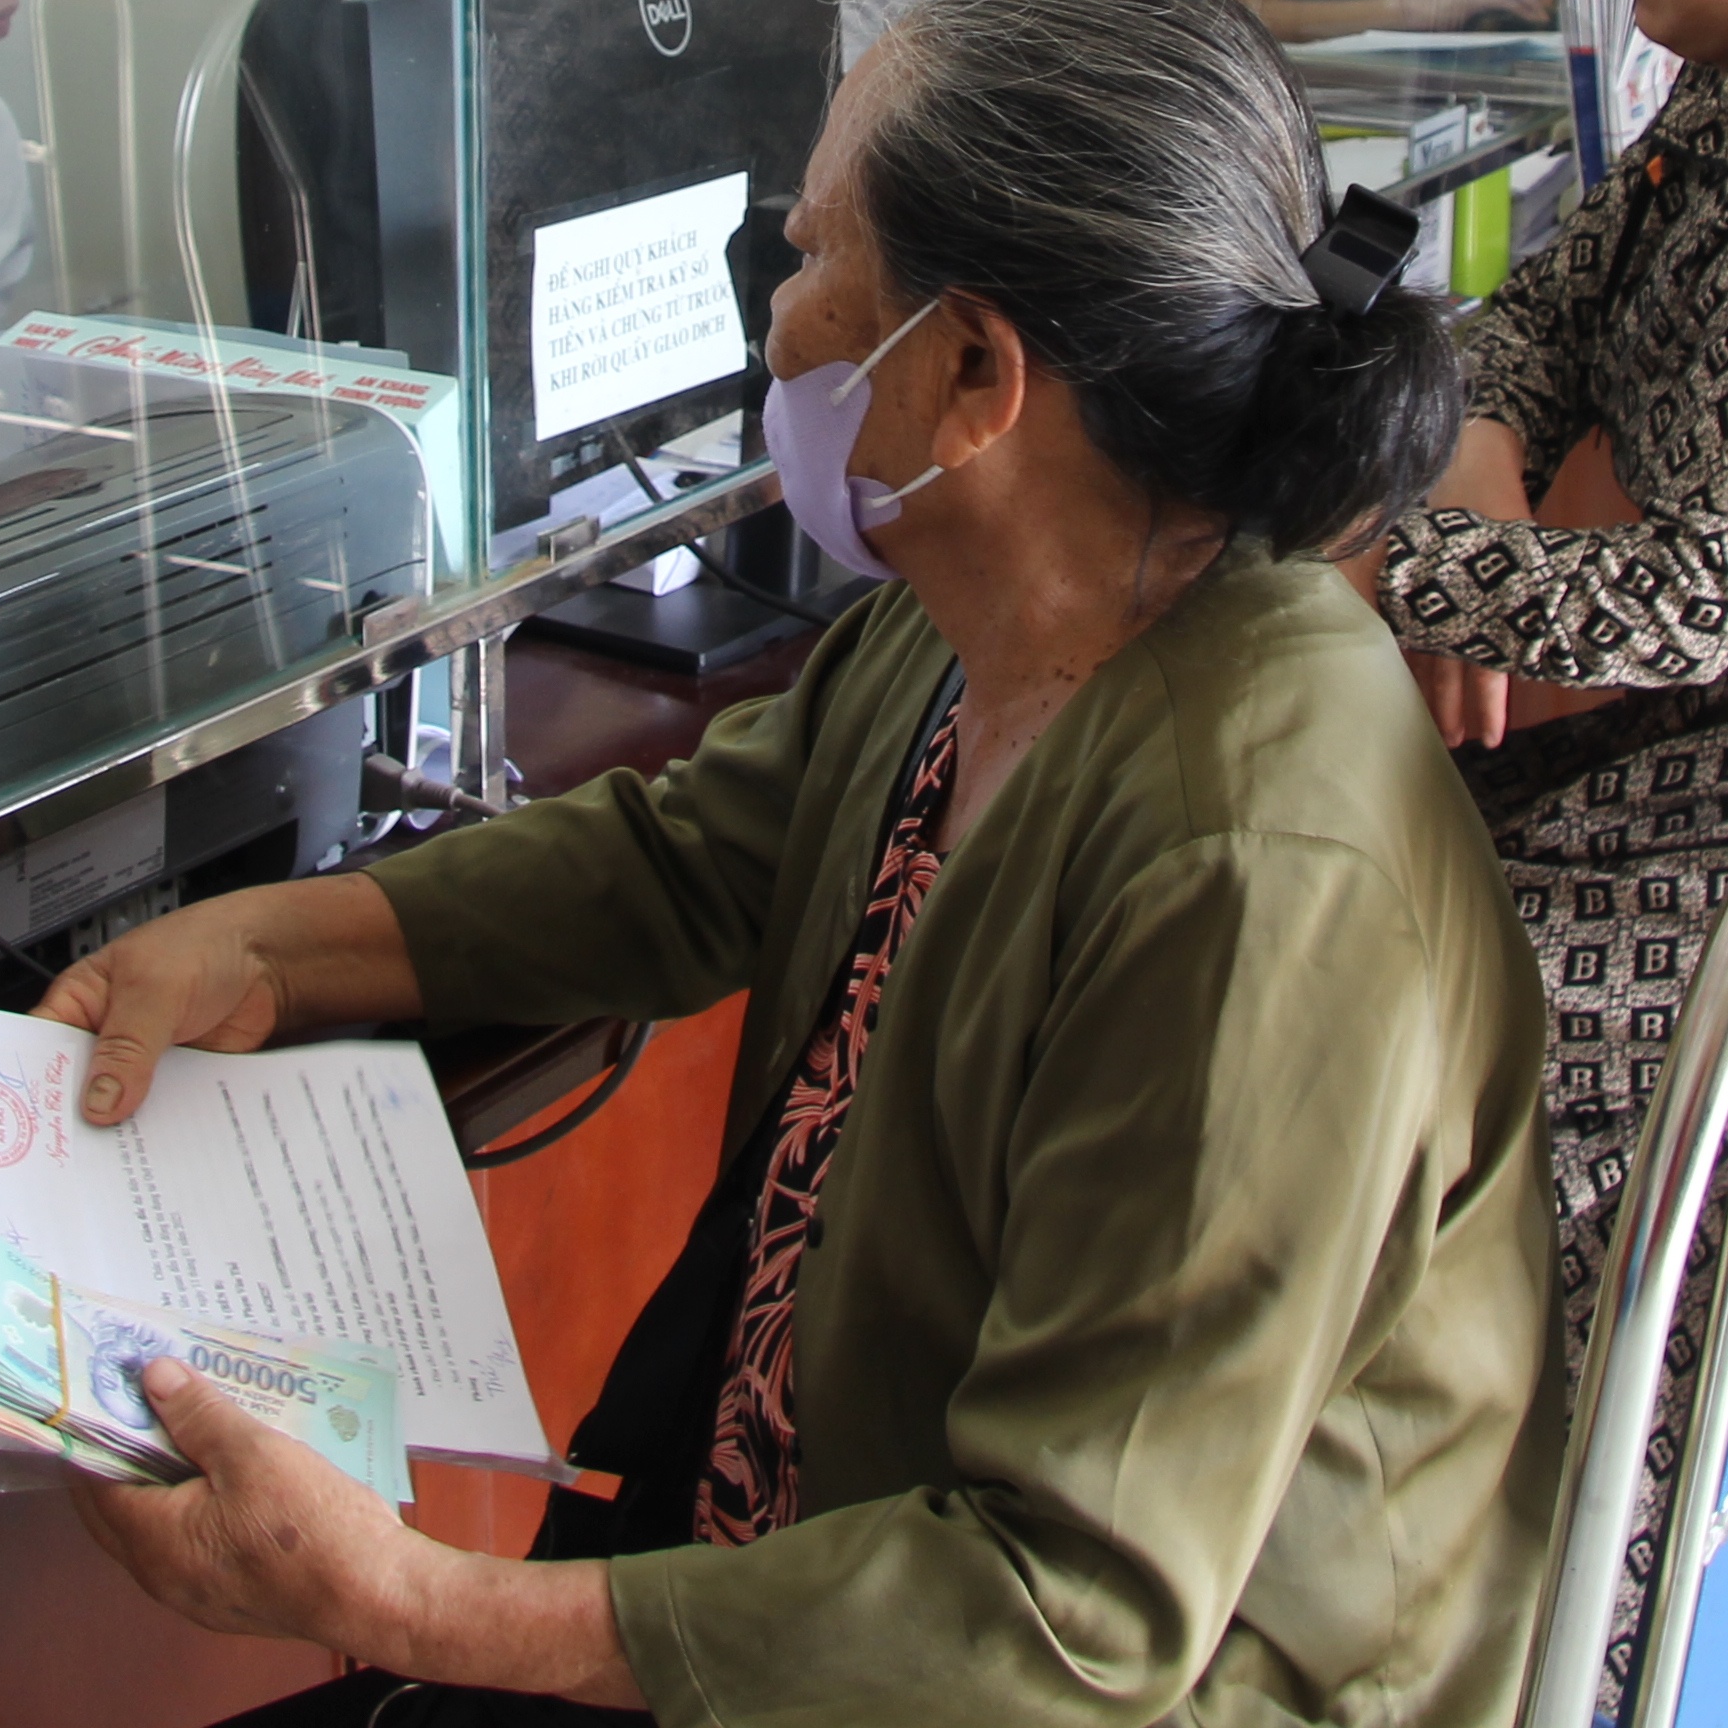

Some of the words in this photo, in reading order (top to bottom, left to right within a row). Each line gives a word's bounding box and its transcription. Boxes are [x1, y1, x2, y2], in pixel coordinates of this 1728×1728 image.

[646, 229, 699, 262] KHÁCH
[547, 294, 593, 326] HÀNG
[595, 276, 635, 312] KIỂM
[636, 272, 666, 299] TRA
[547, 326, 585, 360] TIỀN
[548, 361, 579, 393] KHI
[653, 325, 690, 355] GIAO
[187, 1343, 319, 1406] 500000
